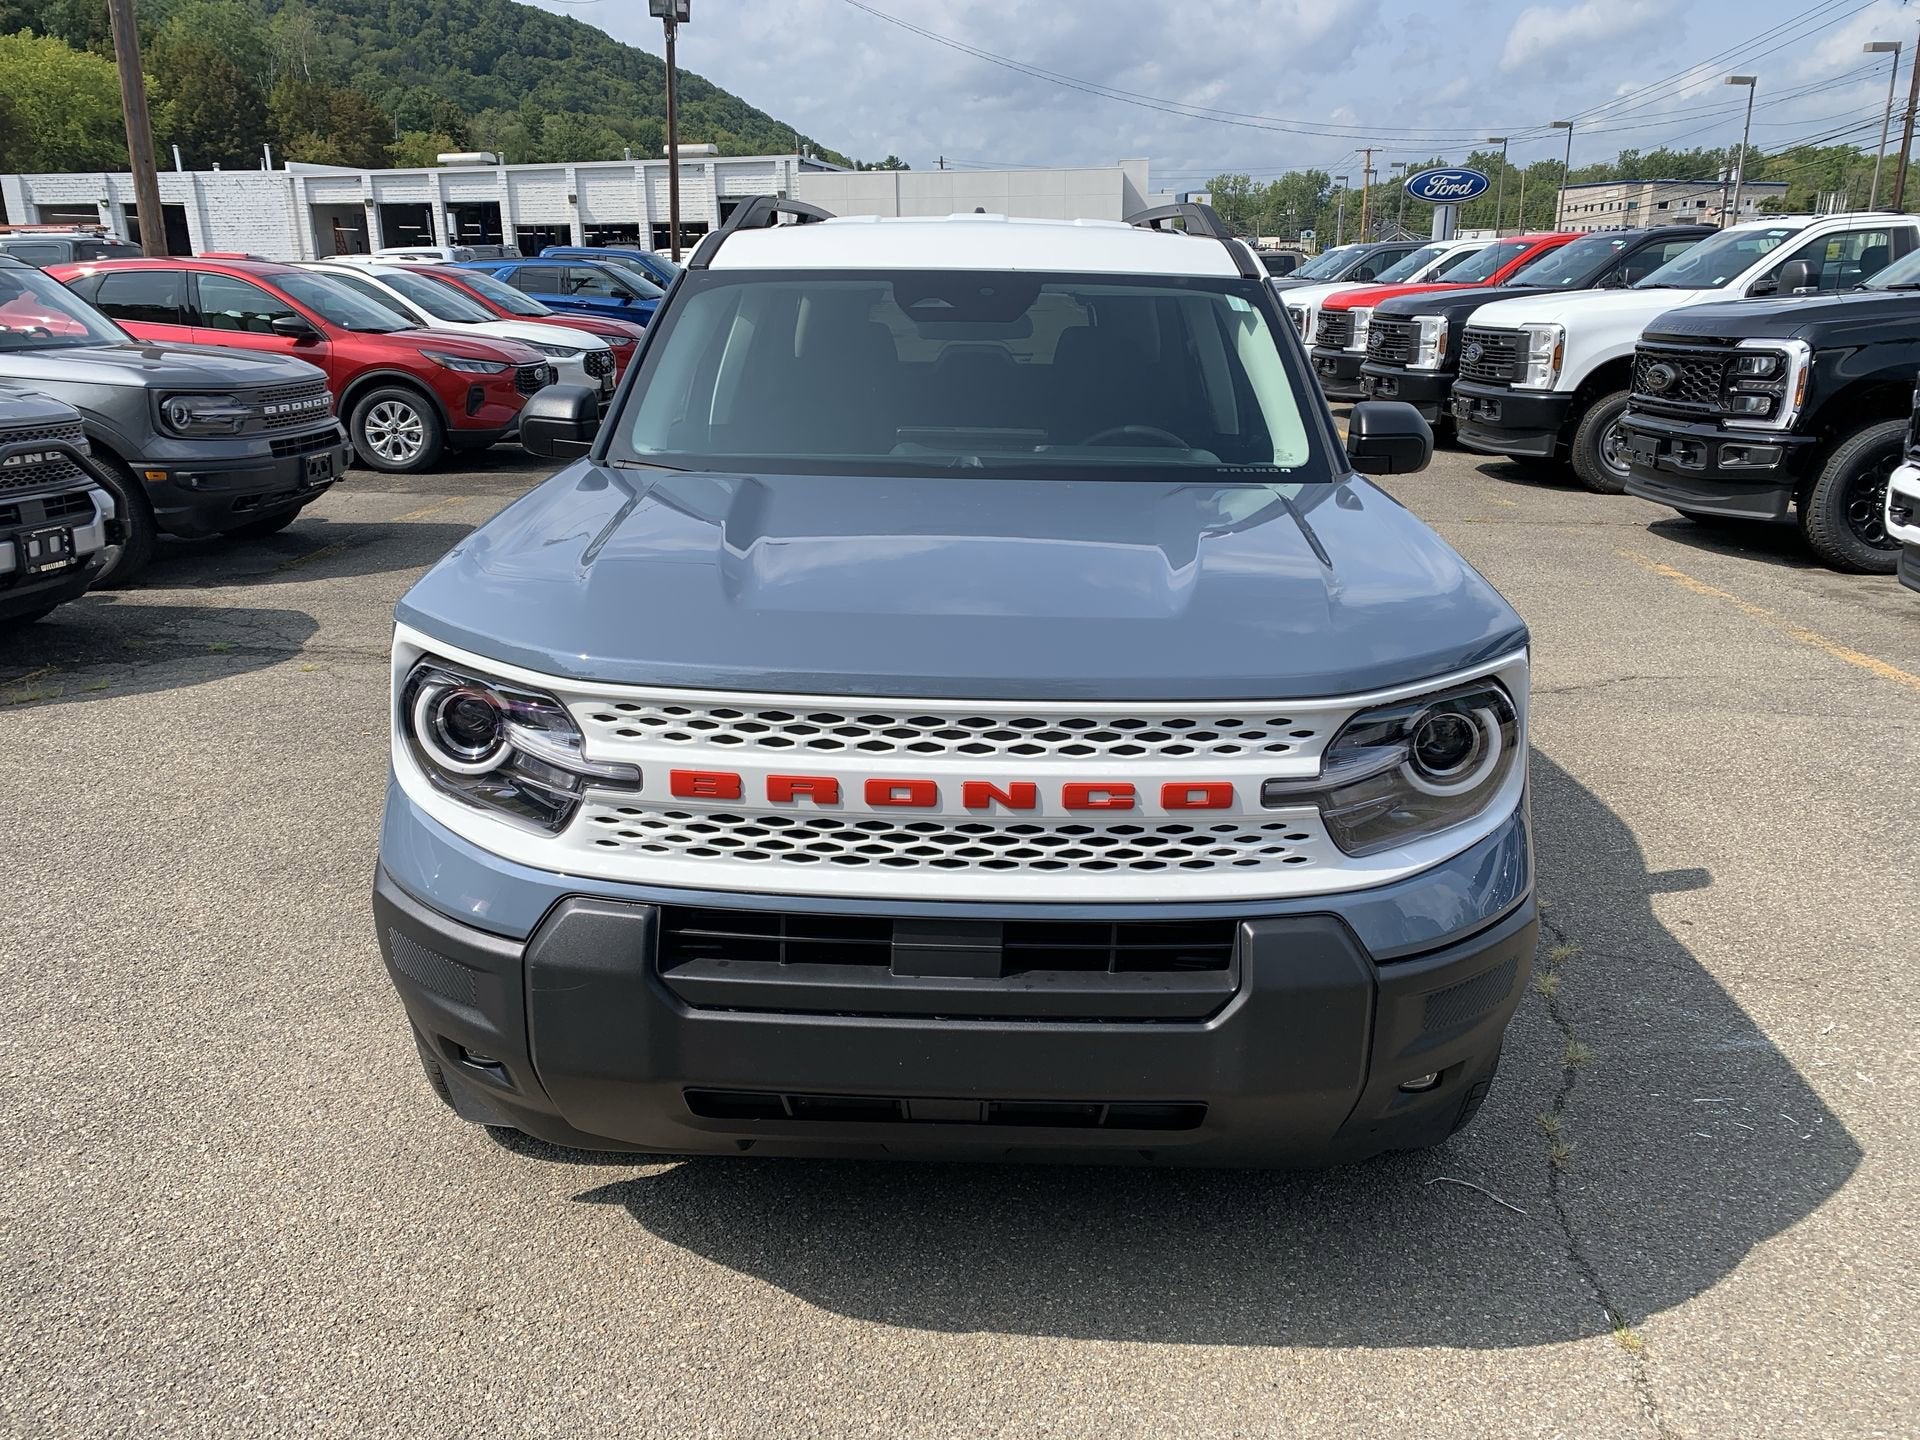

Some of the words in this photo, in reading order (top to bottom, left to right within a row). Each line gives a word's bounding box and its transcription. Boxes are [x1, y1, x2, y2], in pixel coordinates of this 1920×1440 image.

[1424, 174, 1474, 196] Ford
[264, 397, 330, 415] BRONCO
[670, 769, 1234, 810] BRONCO
